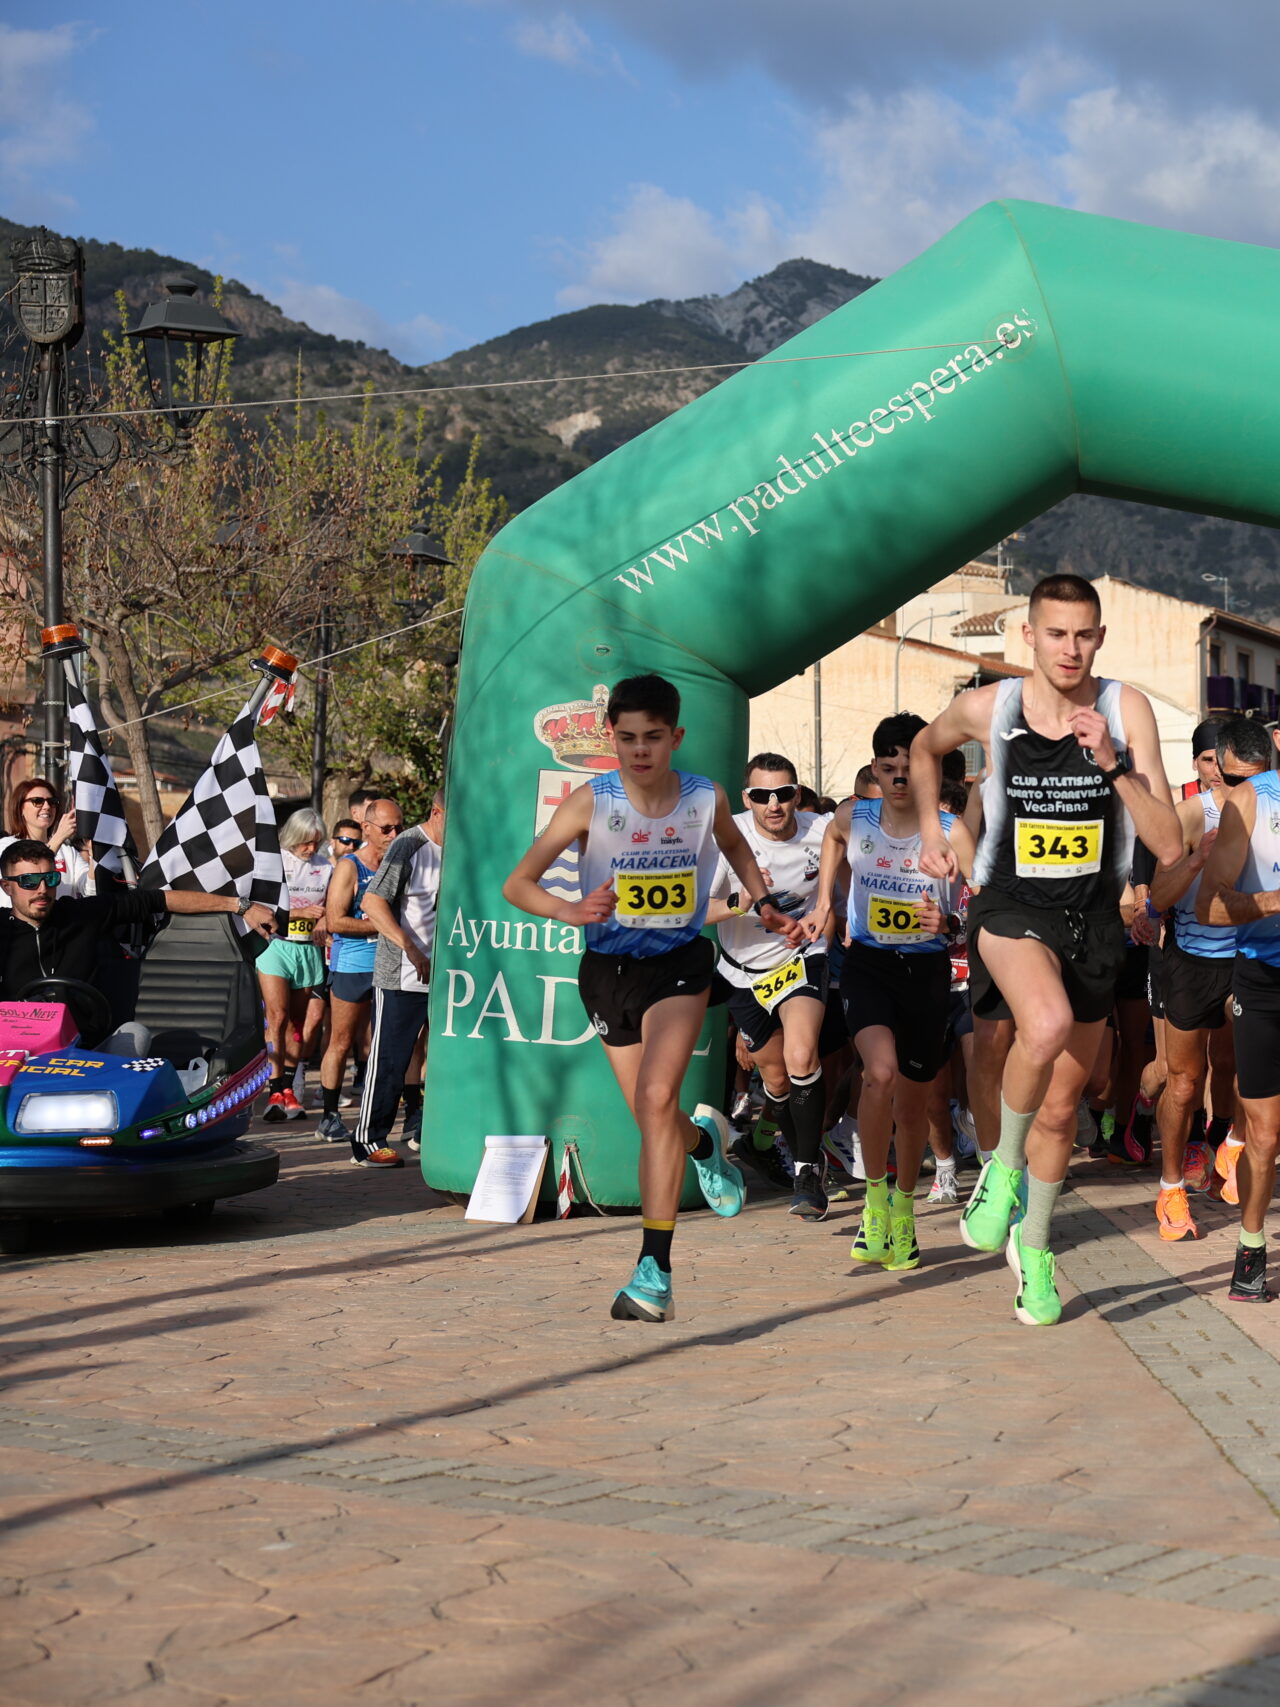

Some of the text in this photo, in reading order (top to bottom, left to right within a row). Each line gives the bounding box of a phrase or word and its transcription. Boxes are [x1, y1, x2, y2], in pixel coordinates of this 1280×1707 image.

[613, 309, 1038, 595] www.padulteespera.es
[1012, 775, 1102, 787] CLUB ATLETISMO
[1046, 787, 1111, 799] TORREVIEJA
[1028, 834, 1089, 859] 343
[610, 853, 697, 870] MARACENA
[860, 875, 934, 894] MARACENA
[628, 883, 686, 910] 303
[289, 921, 314, 932] 380
[762, 970, 798, 999] 364
[48, 1058, 105, 1068] CAR
